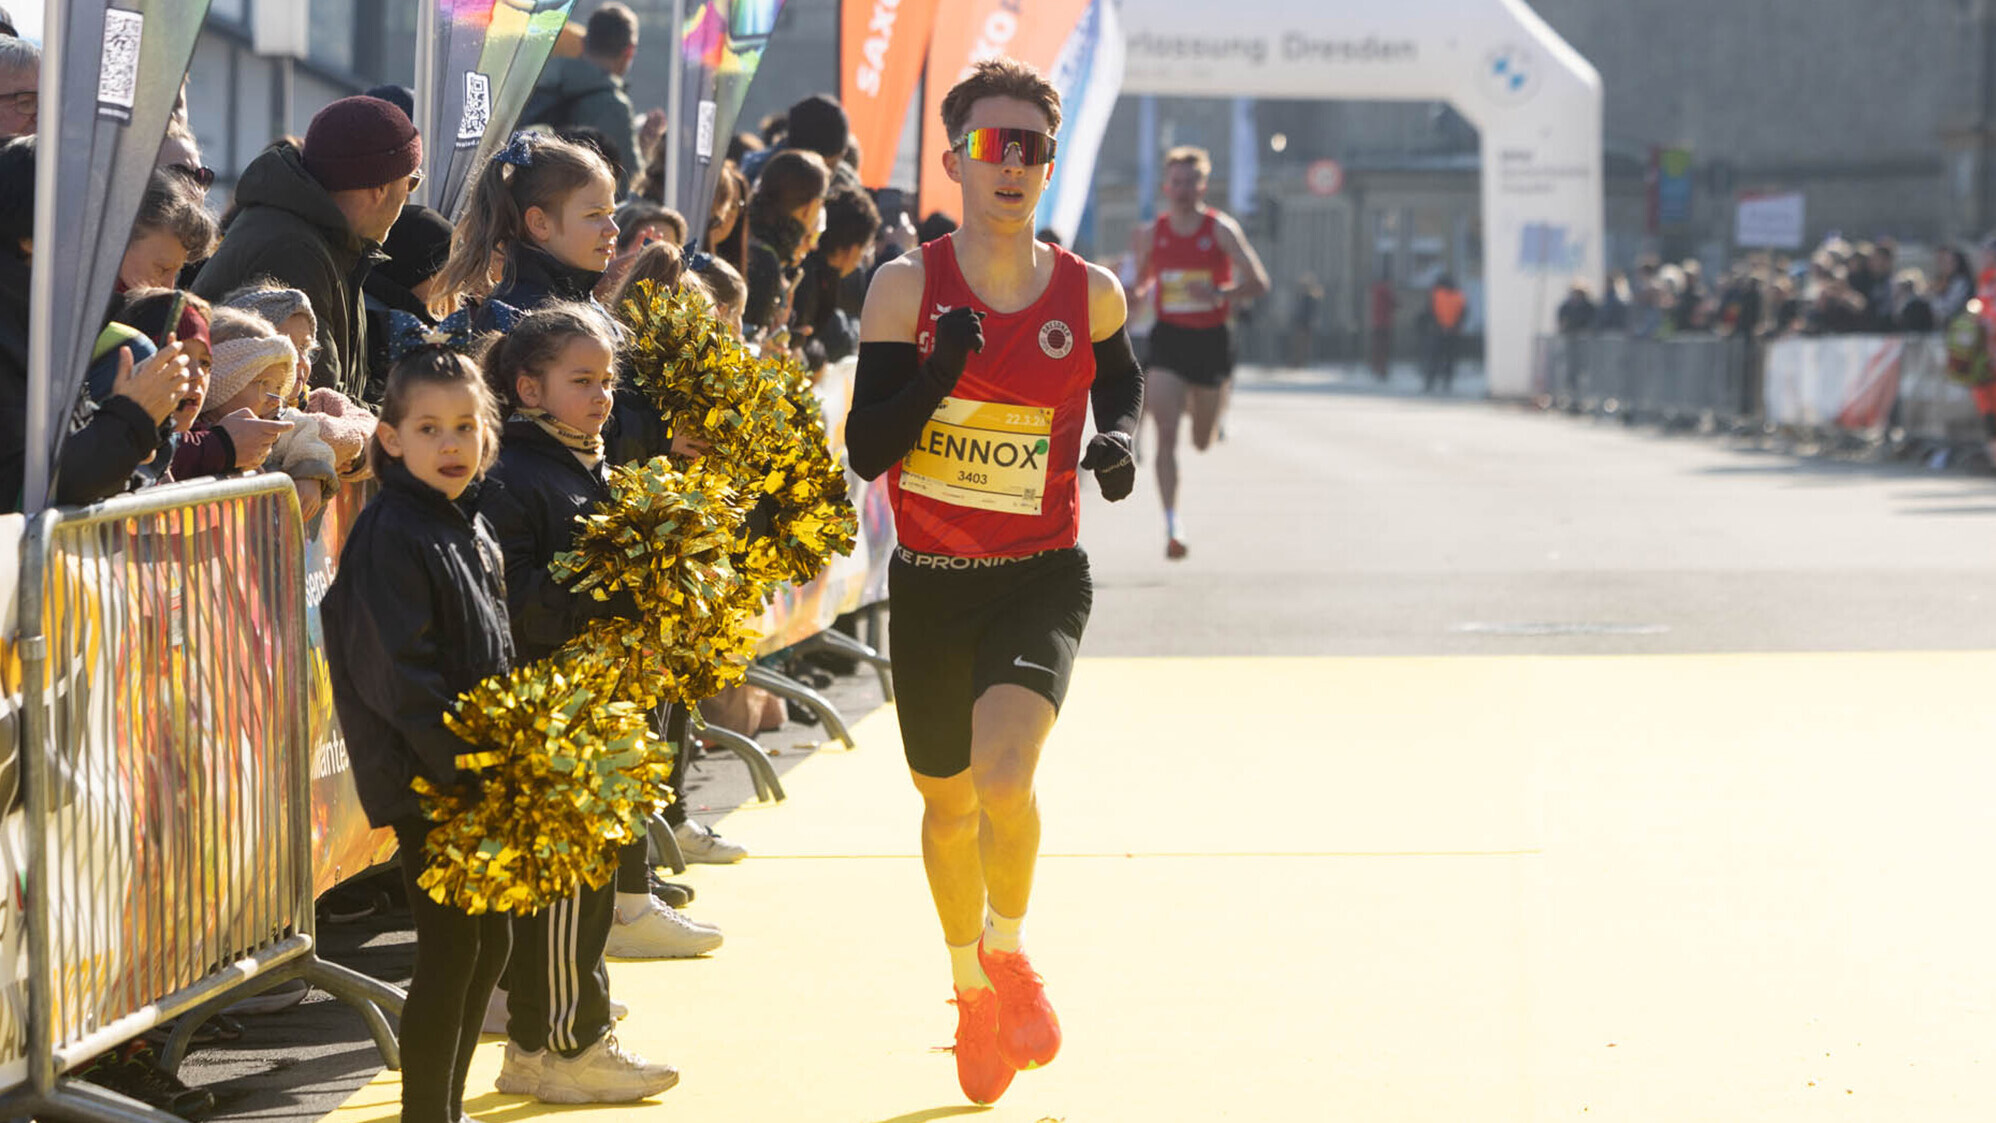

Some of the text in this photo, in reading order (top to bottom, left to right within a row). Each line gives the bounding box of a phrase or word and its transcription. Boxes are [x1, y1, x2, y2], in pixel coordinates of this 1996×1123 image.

[915, 430, 1041, 470] LENNOX
[957, 470, 988, 485] 3403
[915, 554, 971, 570] PRO
